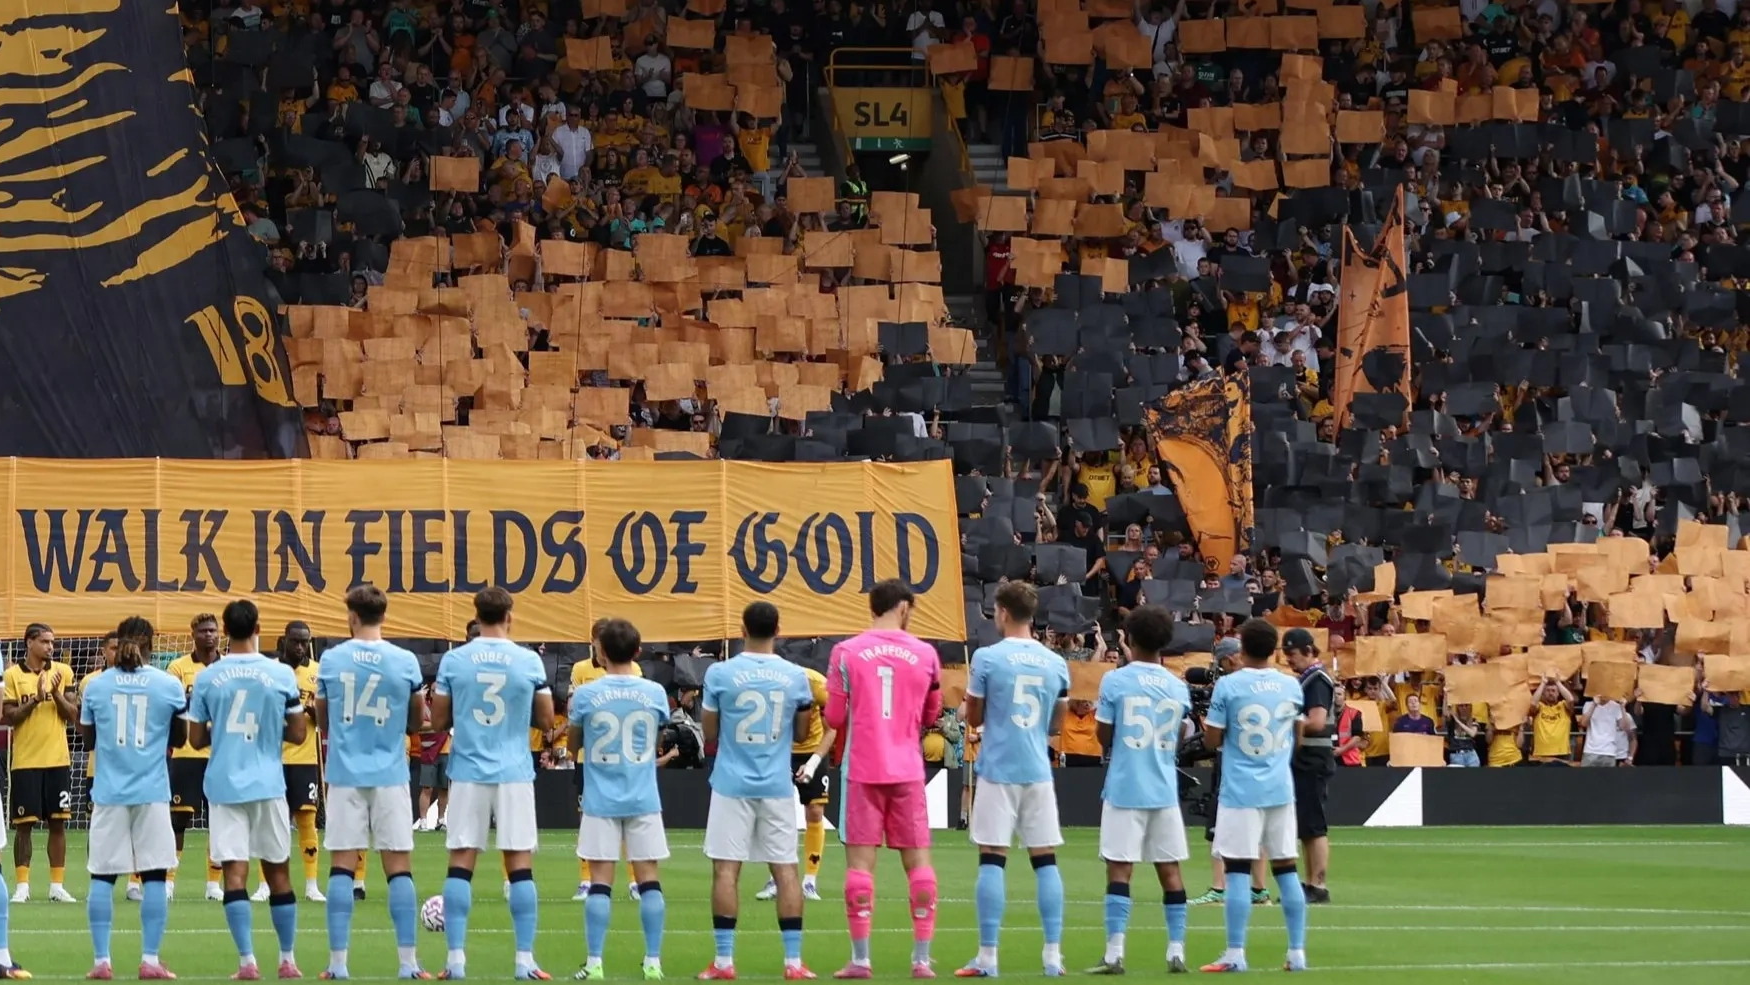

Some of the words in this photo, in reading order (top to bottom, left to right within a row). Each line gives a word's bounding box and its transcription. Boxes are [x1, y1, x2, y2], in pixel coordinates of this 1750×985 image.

[854, 101, 908, 127] SL4
[184, 295, 297, 407] 18
[19, 509, 230, 593] WALK
[255, 510, 326, 593] IN
[347, 510, 587, 594] FIELDS
[606, 511, 707, 595] OF
[729, 511, 940, 595] GOLD
[115, 674, 150, 686] DOKU
[352, 650, 382, 664] NICO
[858, 643, 920, 666] TRAFFORD
[226, 689, 259, 743] 4
[339, 672, 391, 727] 14
[472, 672, 507, 727] 3
[590, 688, 654, 708] BERNARDO
[735, 690, 785, 745] 21
[876, 665, 894, 720] 1
[1010, 674, 1044, 729] 5
[111, 694, 149, 748] 11
[590, 710, 656, 765] 20
[1122, 695, 1183, 751] 52
[1237, 703, 1299, 757] 82
[821, 775, 830, 792] 9
